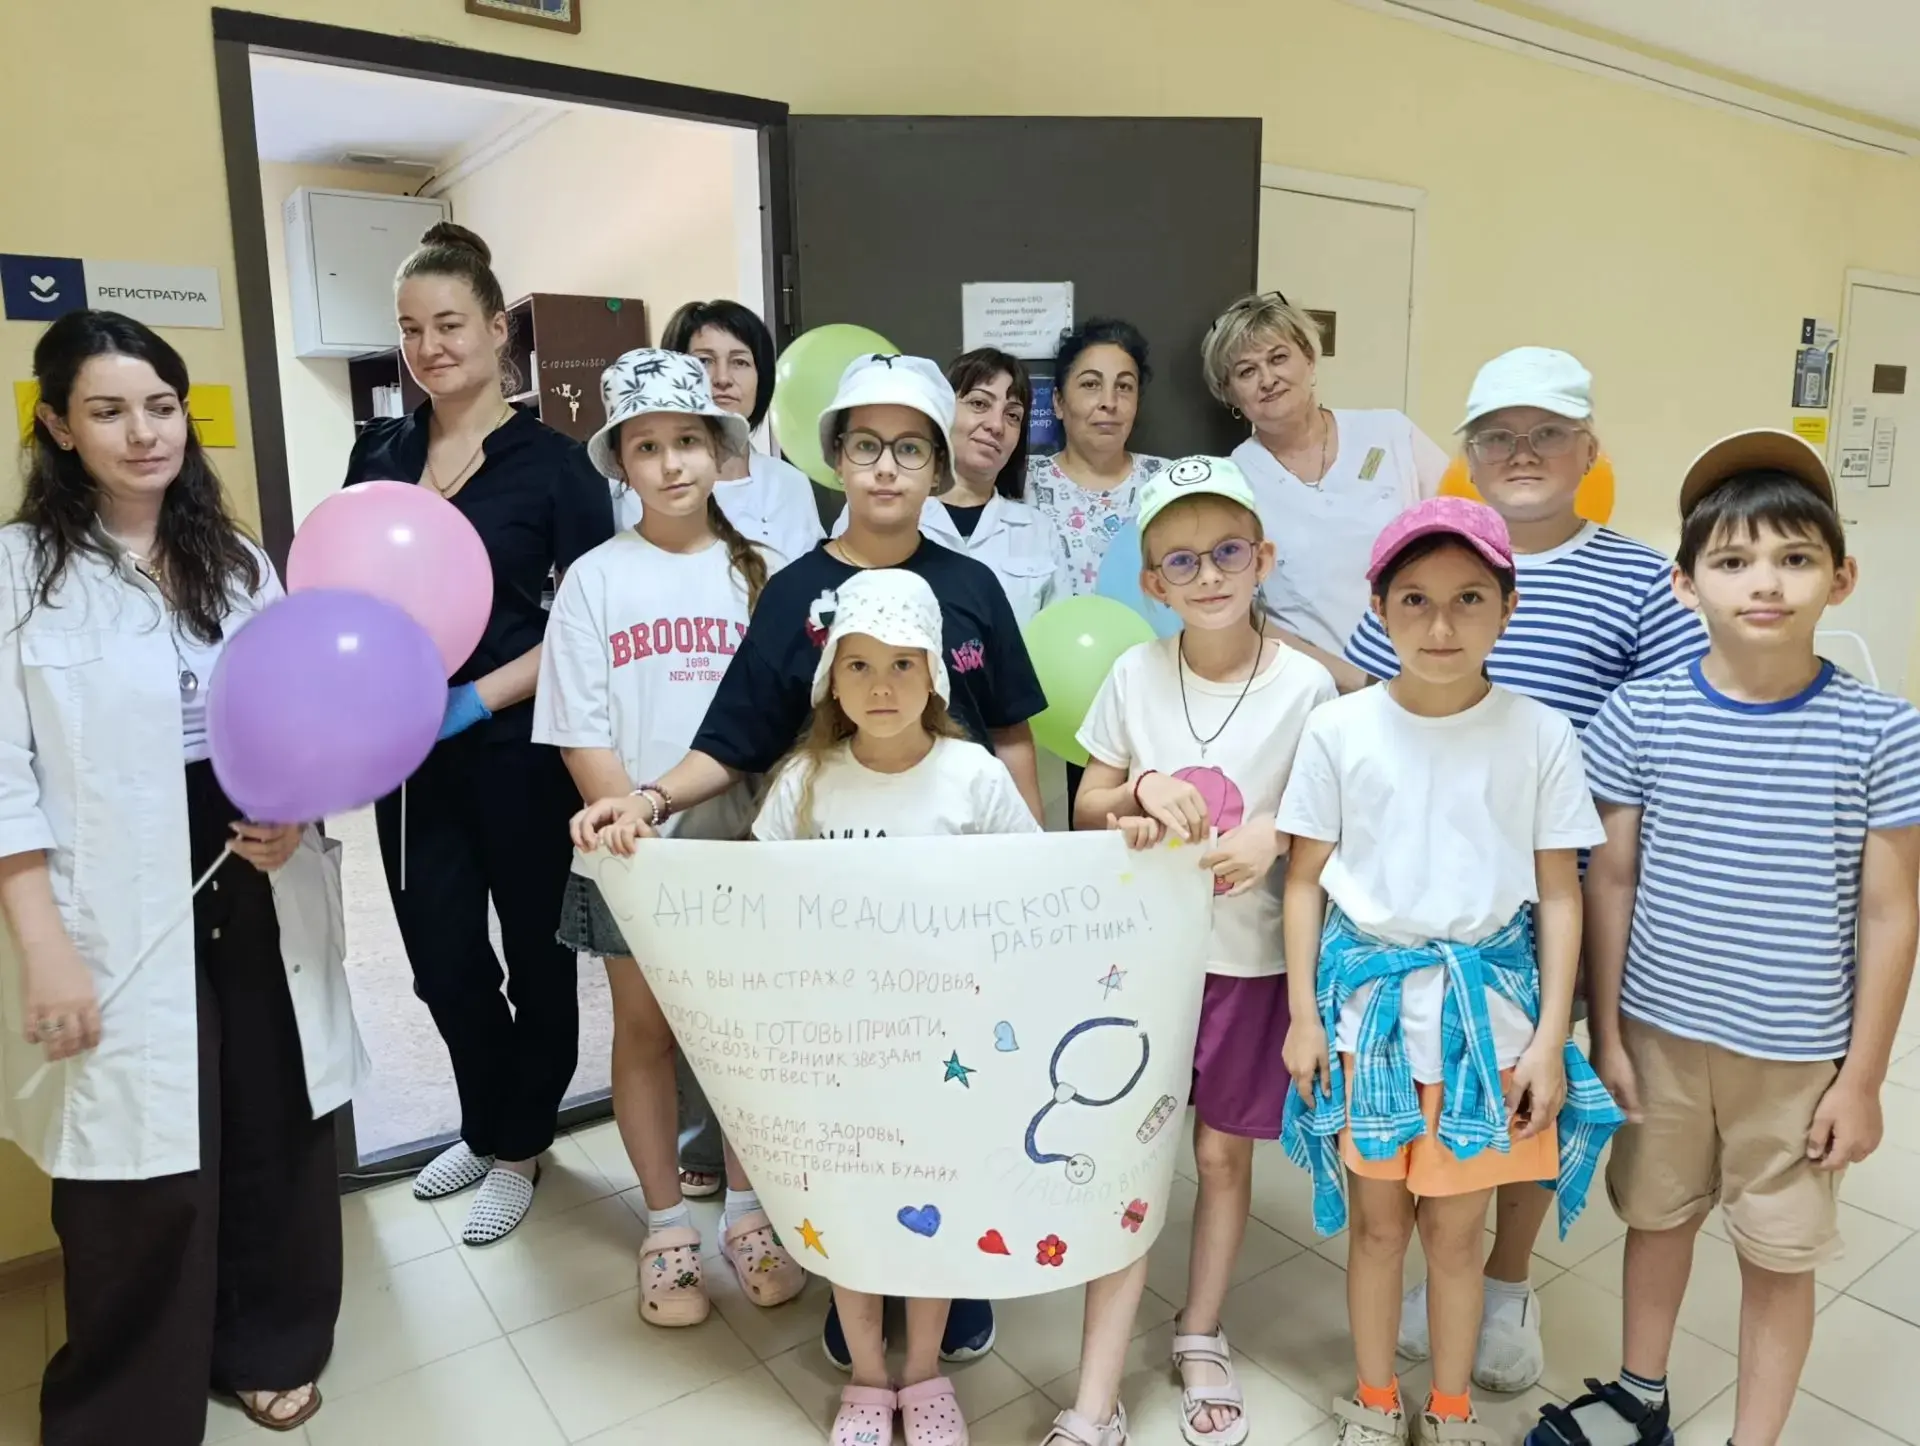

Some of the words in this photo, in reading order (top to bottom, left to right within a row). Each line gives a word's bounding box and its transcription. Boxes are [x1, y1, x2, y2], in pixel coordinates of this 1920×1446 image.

[98, 286, 207, 303] РЕГИСТРАТУРА
[669, 671, 694, 682] NEW
[706, 969, 734, 990] ВЫ
[742, 971, 769, 991] НА
[867, 967, 981, 996] ЗДОРОВЬЯ,
[755, 1019, 852, 1046] ГОТОВЫ
[700, 1035, 760, 1061] СКВОЗЬ
[761, 1114, 806, 1134] САМИ
[818, 1121, 905, 1147] ЗДОРОВЫ,
[891, 1161, 960, 1186] БУДНЯХ
